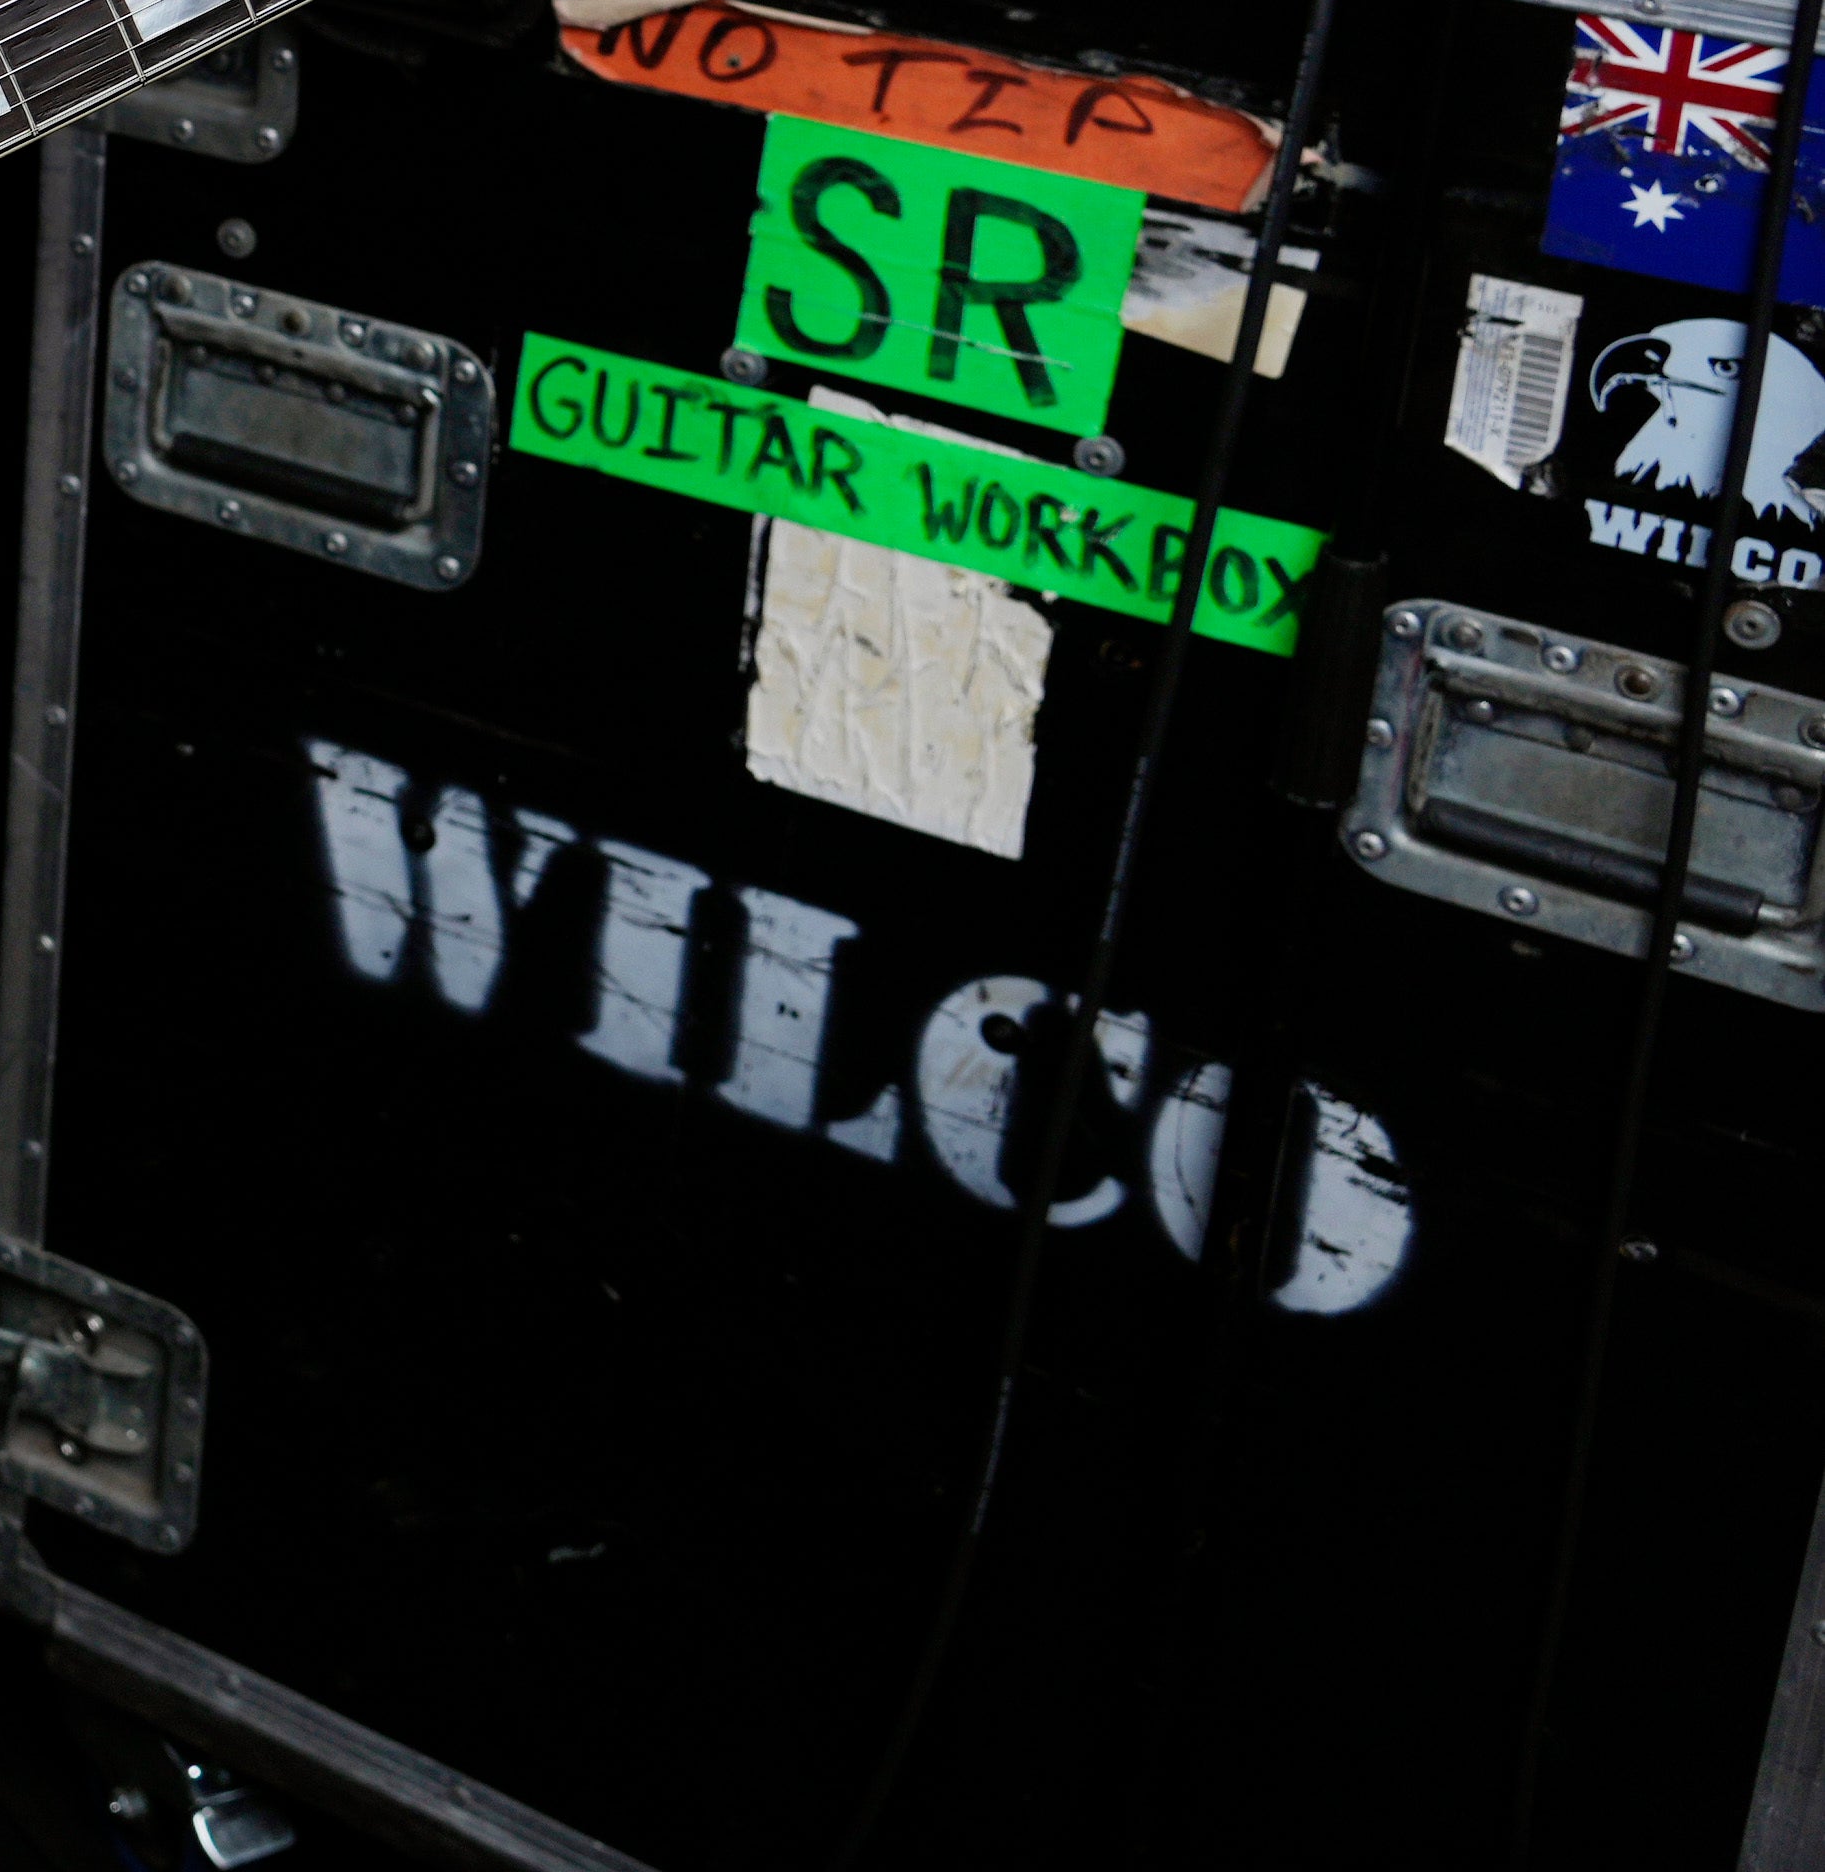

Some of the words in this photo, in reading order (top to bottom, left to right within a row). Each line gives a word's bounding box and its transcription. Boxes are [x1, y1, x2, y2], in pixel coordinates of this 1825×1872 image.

[596, 3, 777, 84] NO
[761, 154, 1085, 410] SR
[527, 354, 867, 517] GUITAR
[303, 738, 1414, 1316] WILCO
